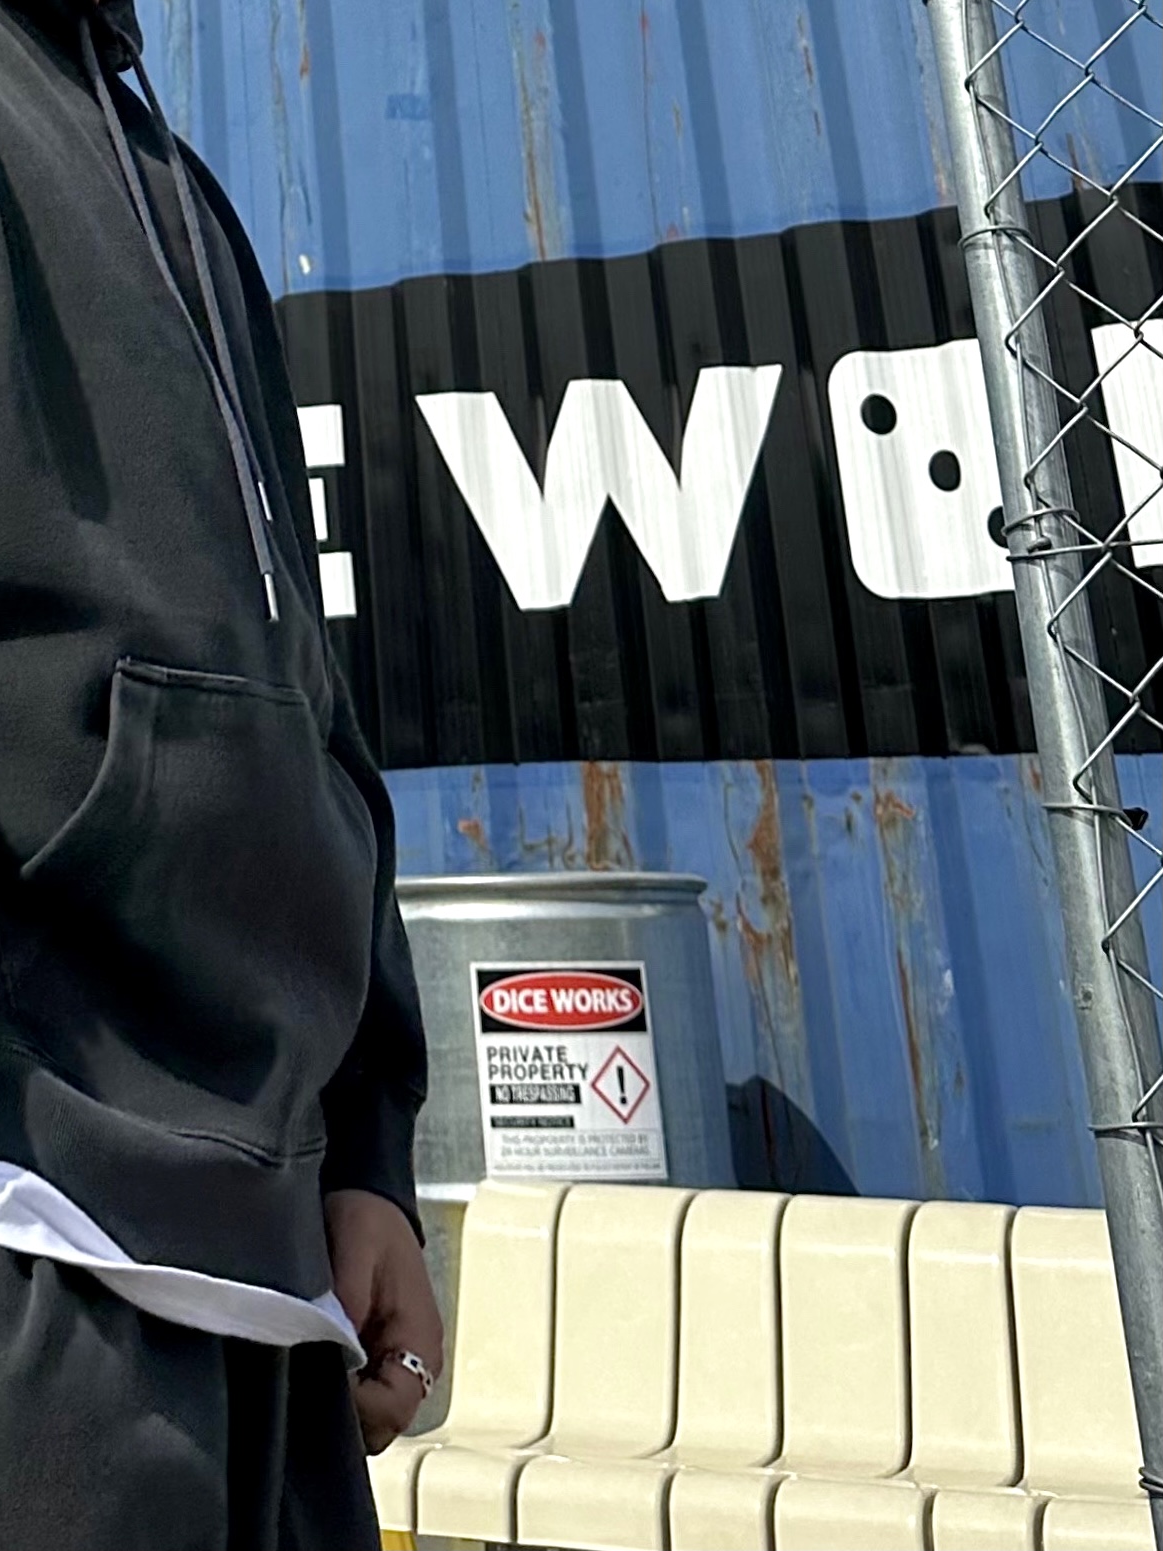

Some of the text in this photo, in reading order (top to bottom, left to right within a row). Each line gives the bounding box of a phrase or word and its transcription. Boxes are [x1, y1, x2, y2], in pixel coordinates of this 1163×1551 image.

[492, 988, 634, 1014] DICE WORKS
[486, 1045, 568, 1063] PRIVATE
[488, 1062, 588, 1082] PROPERTY
[495, 1084, 512, 1104] NO
